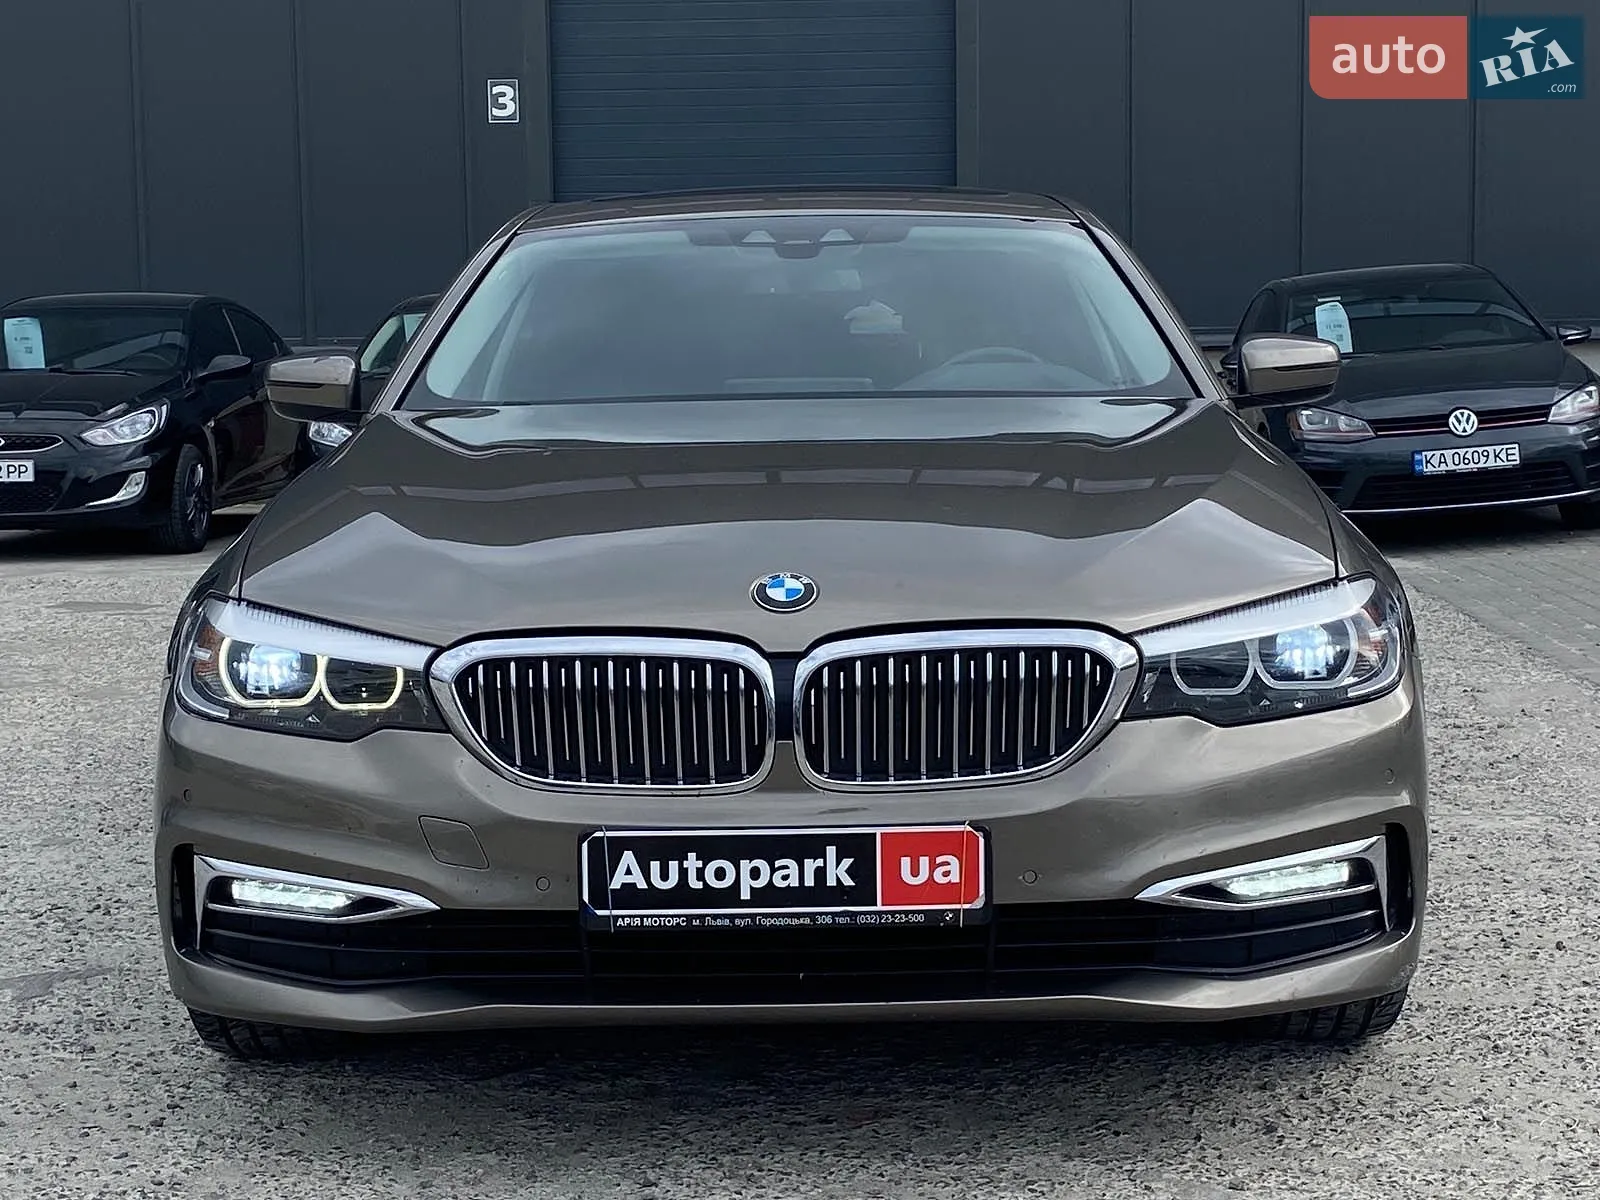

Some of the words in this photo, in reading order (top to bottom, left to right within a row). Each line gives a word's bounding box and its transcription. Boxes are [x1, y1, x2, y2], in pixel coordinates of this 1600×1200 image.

[492, 85, 515, 117] 3
[1424, 452, 1449, 469] KA
[1451, 449, 1490, 466] 0609
[1493, 446, 1518, 463] KE
[609, 846, 855, 900] Autopark
[900, 855, 960, 885] ua
[616, 917, 641, 927] АРІЯ
[643, 917, 687, 927] МОТОРС
[692, 918, 702, 926] м.
[704, 916, 733, 927] Львів,
[735, 917, 753, 928] вул.
[756, 914, 814, 926] Городоцька,
[815, 915, 833, 924] 306
[856, 914, 880, 924] (032)
[881, 913, 925, 923] 23-23-500
